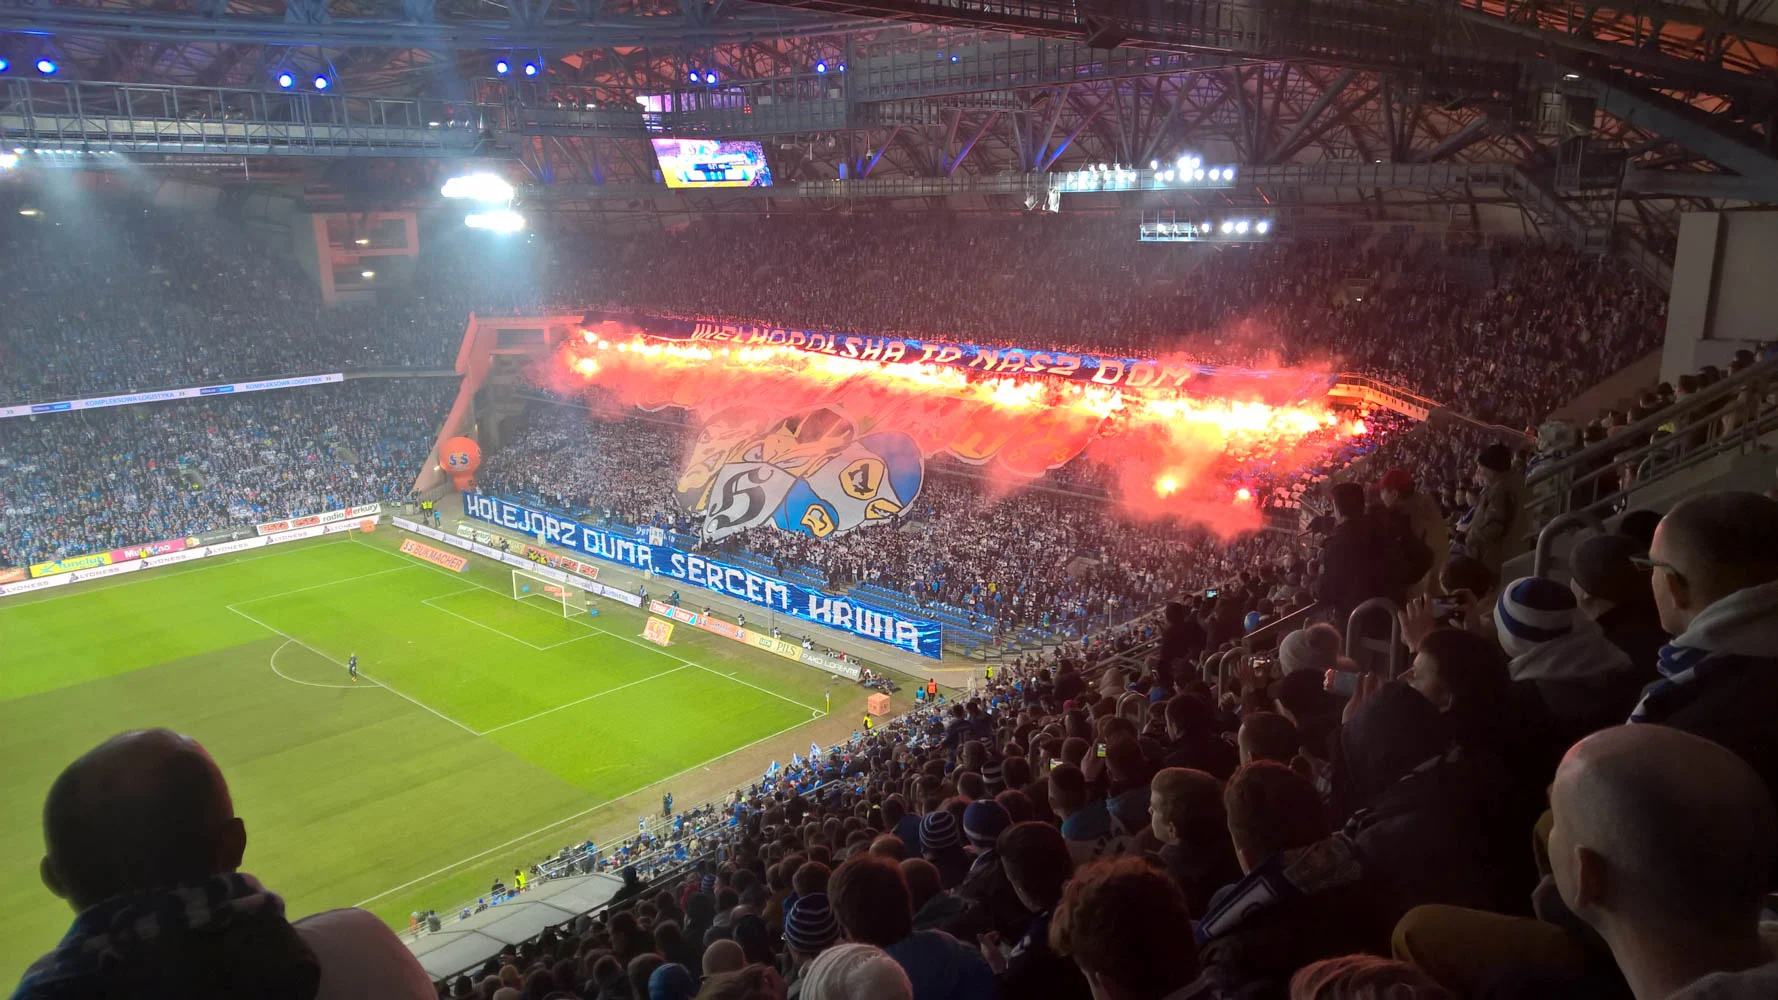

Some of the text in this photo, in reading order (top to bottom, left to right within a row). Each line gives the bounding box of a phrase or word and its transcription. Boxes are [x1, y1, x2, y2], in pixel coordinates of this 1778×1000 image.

[968, 348, 1081, 376] NASZ
[1091, 359, 1192, 387] DOM
[322, 512, 344, 522] radio
[344, 503, 379, 519] Merkury
[213, 542, 249, 553] LYONESS
[148, 554, 186, 565] LYONESS
[413, 545, 464, 569] BUKMACHER
[79, 567, 119, 579] LYONESS
[6, 580, 49, 593] LYONESS
[776, 641, 797, 656] PILS
[802, 652, 858, 677] PAKO LORENTE
